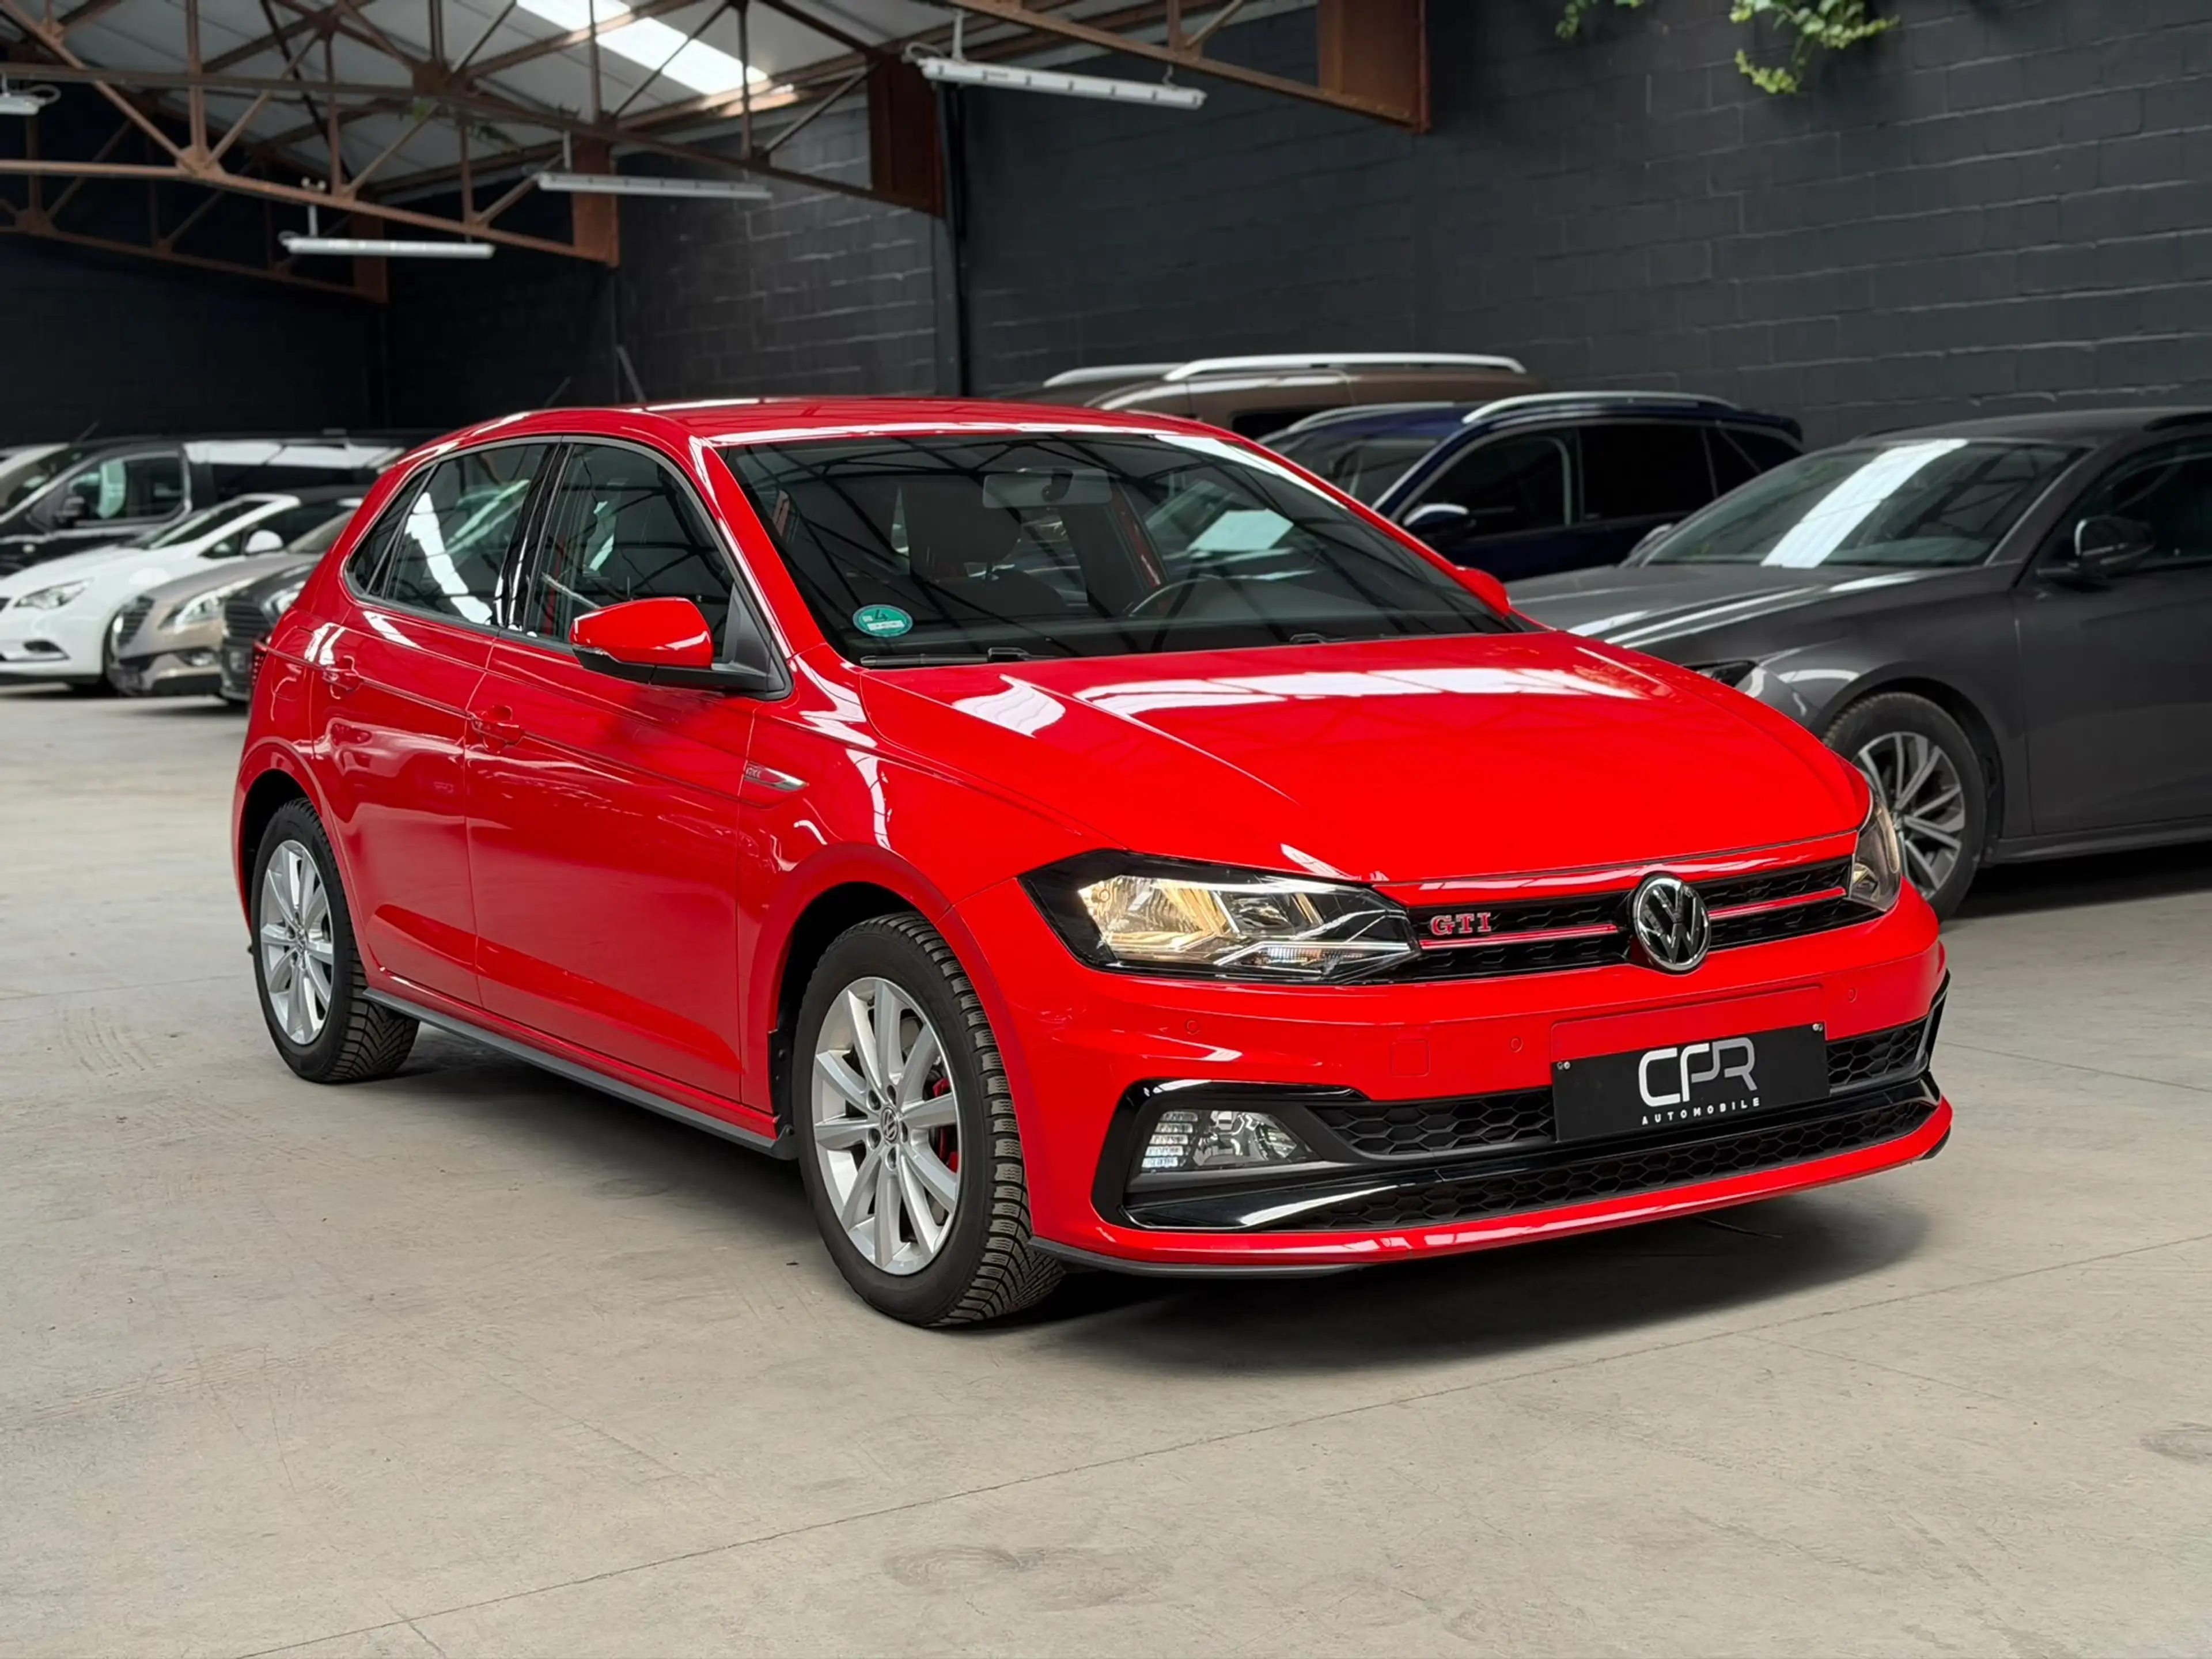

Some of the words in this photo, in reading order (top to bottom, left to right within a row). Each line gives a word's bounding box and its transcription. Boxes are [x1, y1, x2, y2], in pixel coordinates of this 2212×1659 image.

[1430, 912, 1492, 935] GTI
[1638, 1037, 1757, 1107] CPR
[1642, 1097, 1760, 1125] AUTOMOBILE
